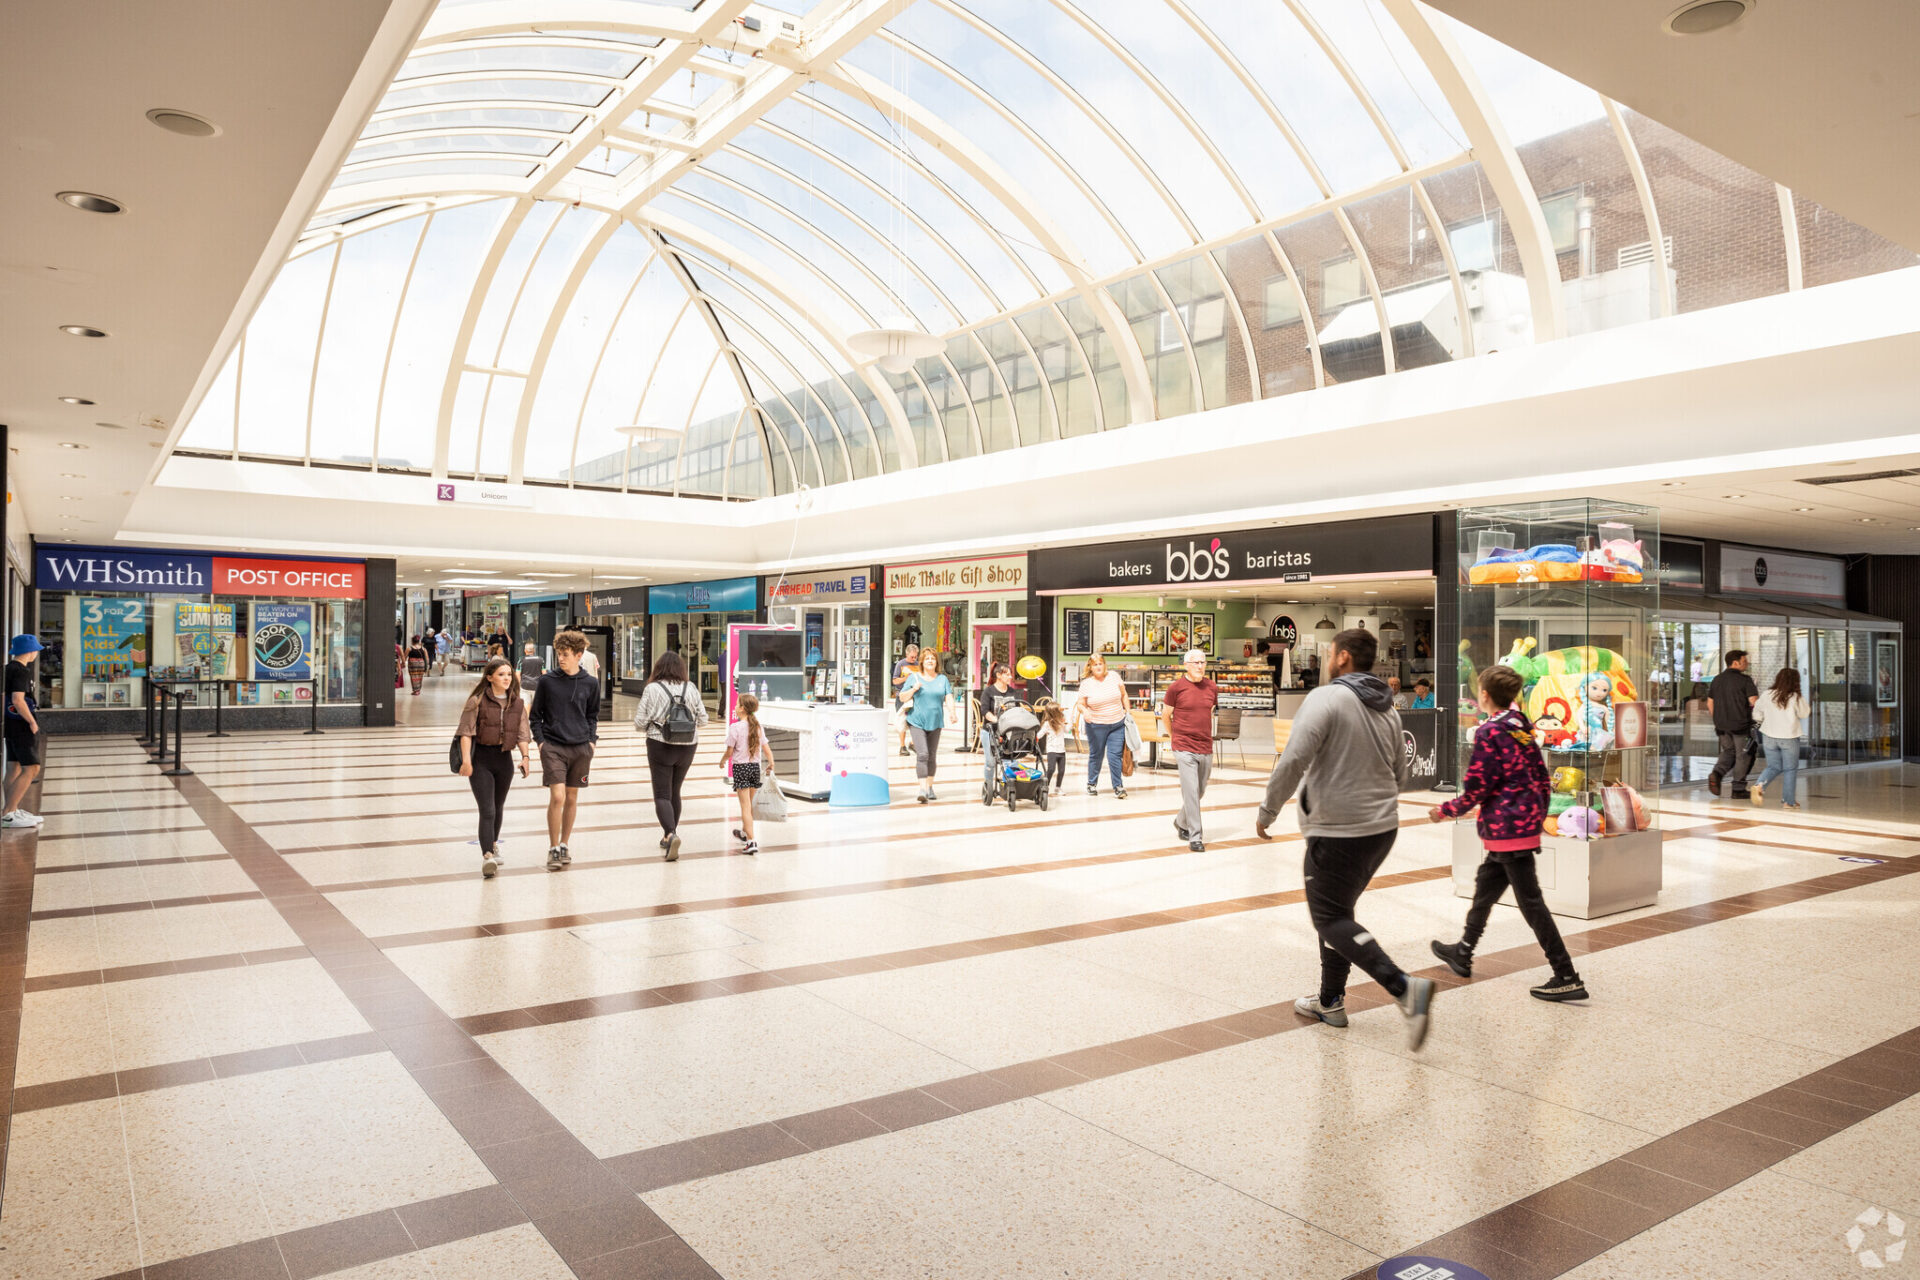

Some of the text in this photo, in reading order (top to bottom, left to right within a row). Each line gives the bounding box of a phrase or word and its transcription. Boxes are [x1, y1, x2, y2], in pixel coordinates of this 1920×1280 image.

[481, 492, 508, 500] Unicorn
[1109, 537, 1312, 582] bakers bb's baristas
[46, 557, 205, 586] WHSmith
[227, 568, 353, 588] POST OFFICE
[890, 565, 1022, 589] Little Thistle Gift Shop
[769, 583, 812, 597] BARRHEAD
[814, 580, 847, 593] TRAVEL
[83, 600, 103, 623] 3
[123, 600, 143, 623] 2
[179, 612, 233, 627] SUMMER
[83, 624, 119, 637] ALL
[255, 625, 287, 645] BOOK
[84, 639, 119, 650] Kids'
[84, 651, 129, 663] Books
[266, 659, 288, 667] PRICE
[1402, 1266, 1425, 1278] STAY
